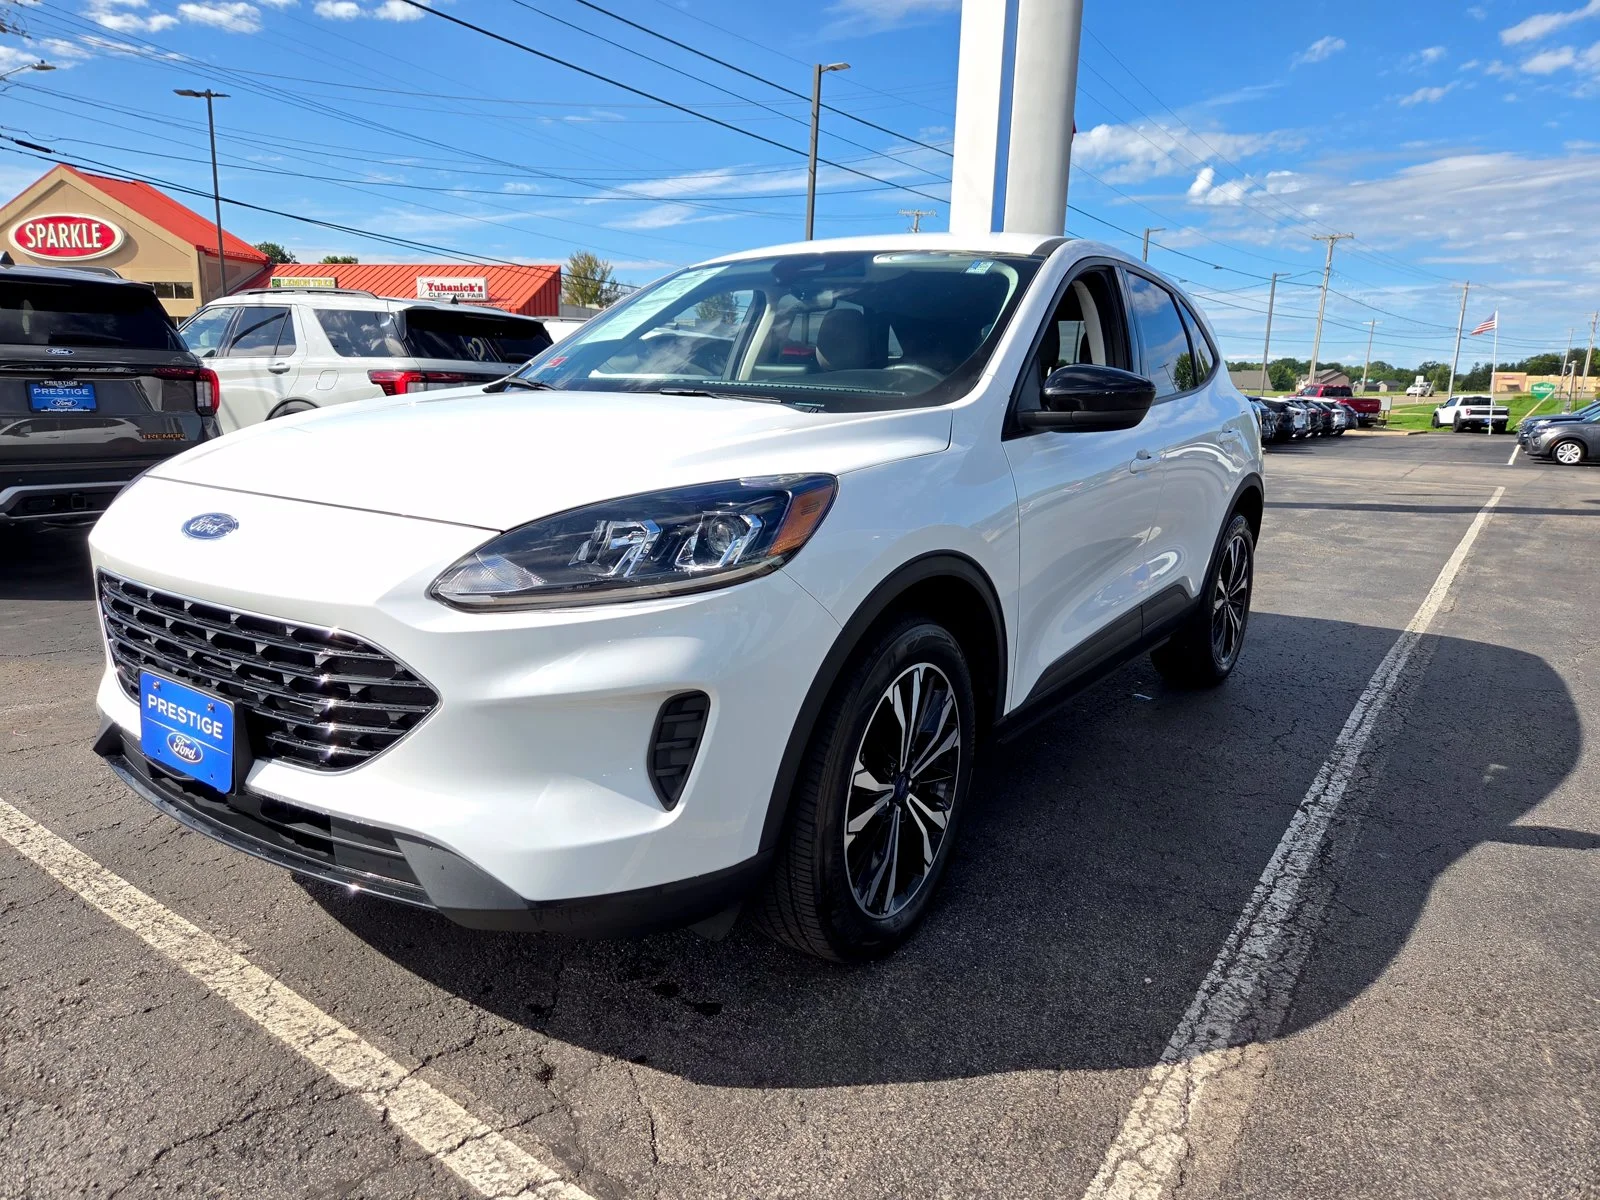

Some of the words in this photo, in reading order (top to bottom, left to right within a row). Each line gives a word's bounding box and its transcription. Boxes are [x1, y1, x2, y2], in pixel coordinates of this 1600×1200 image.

[25, 222, 103, 249] SPARKLE
[427, 282, 484, 293] Yuhanick's
[142, 432, 185, 440] TREMOR
[147, 693, 224, 740] PRESTIGE
[172, 735, 198, 760] Ford
